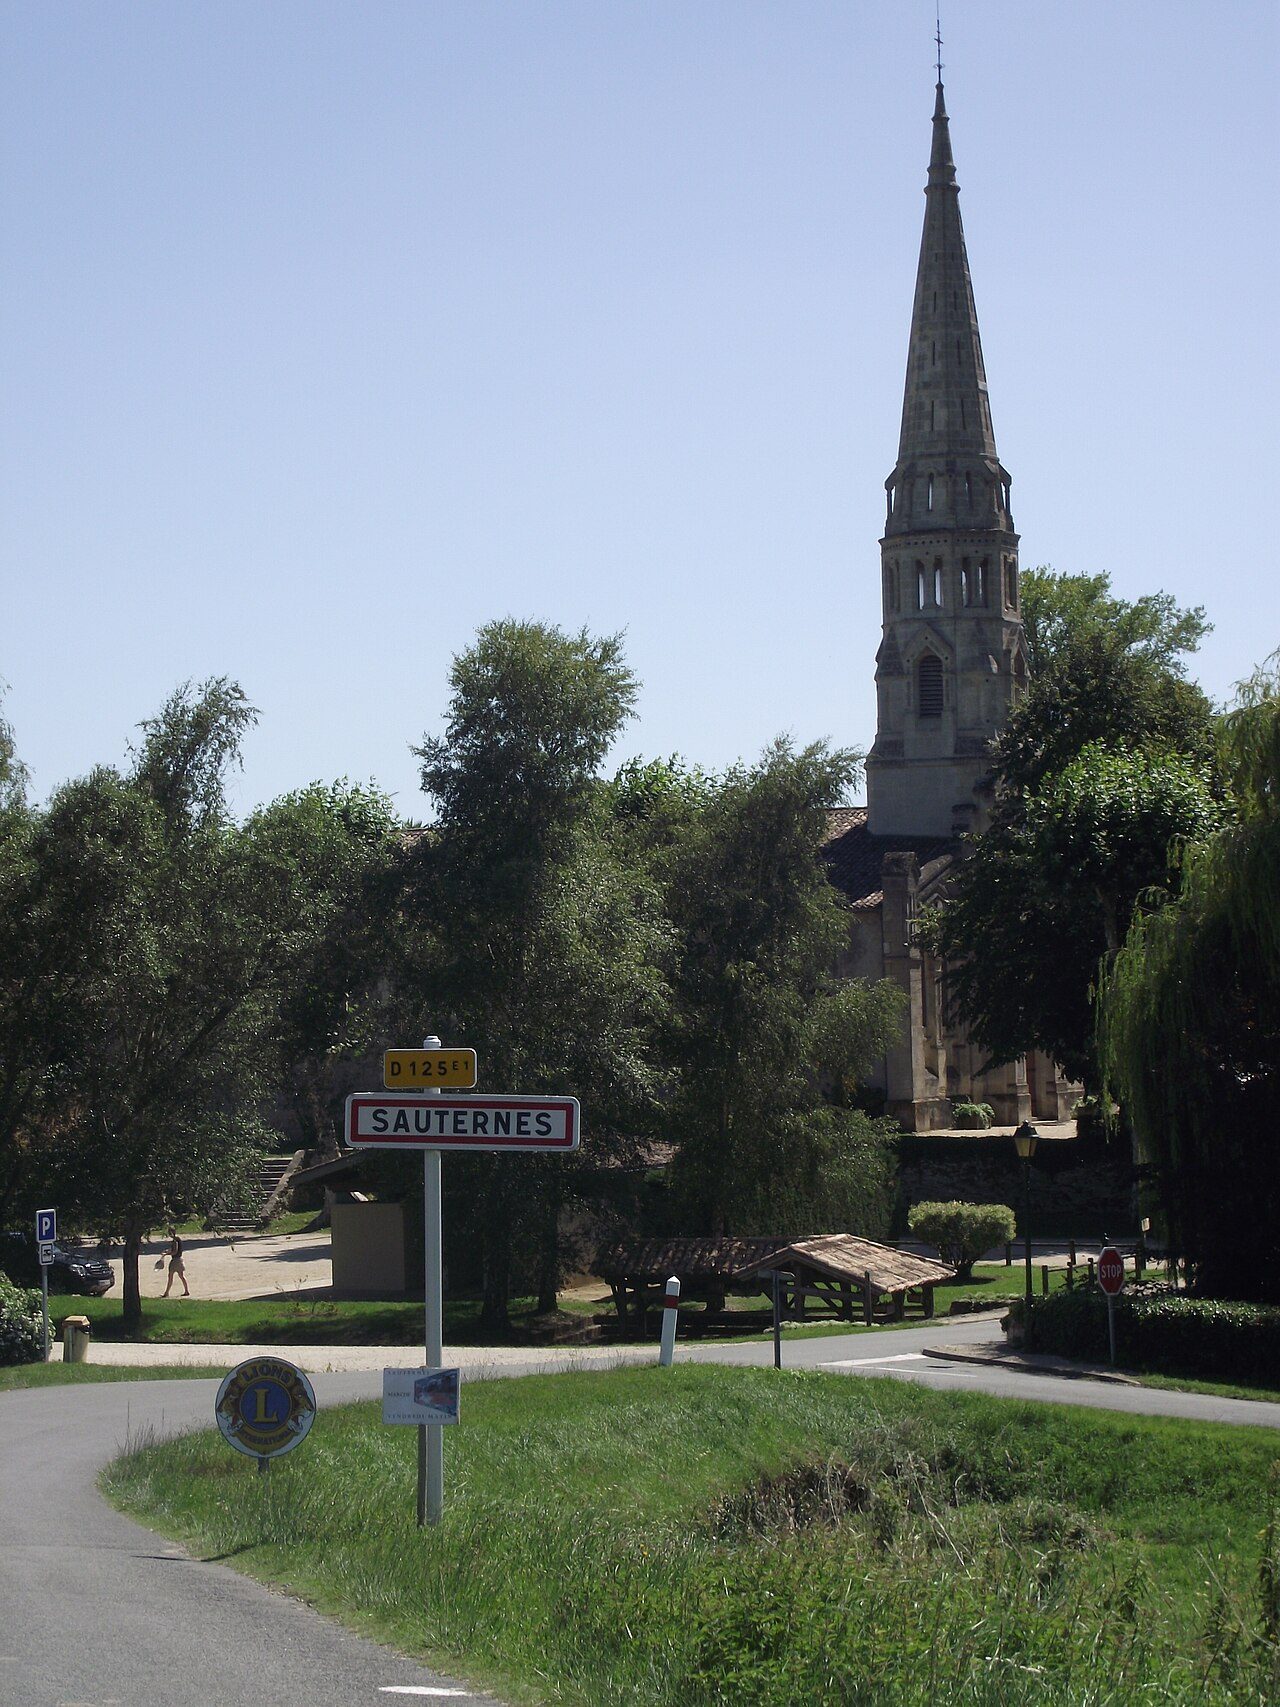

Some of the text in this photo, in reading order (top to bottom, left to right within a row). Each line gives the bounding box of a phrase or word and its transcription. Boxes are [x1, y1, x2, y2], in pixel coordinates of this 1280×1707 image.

[390, 1061, 402, 1076] D
[372, 1108, 552, 1137] SAUTERNES
[43, 1217, 50, 1236] P
[1101, 1264, 1122, 1279] STOP
[241, 1363, 292, 1384] LIONS
[253, 1388, 278, 1423] L
